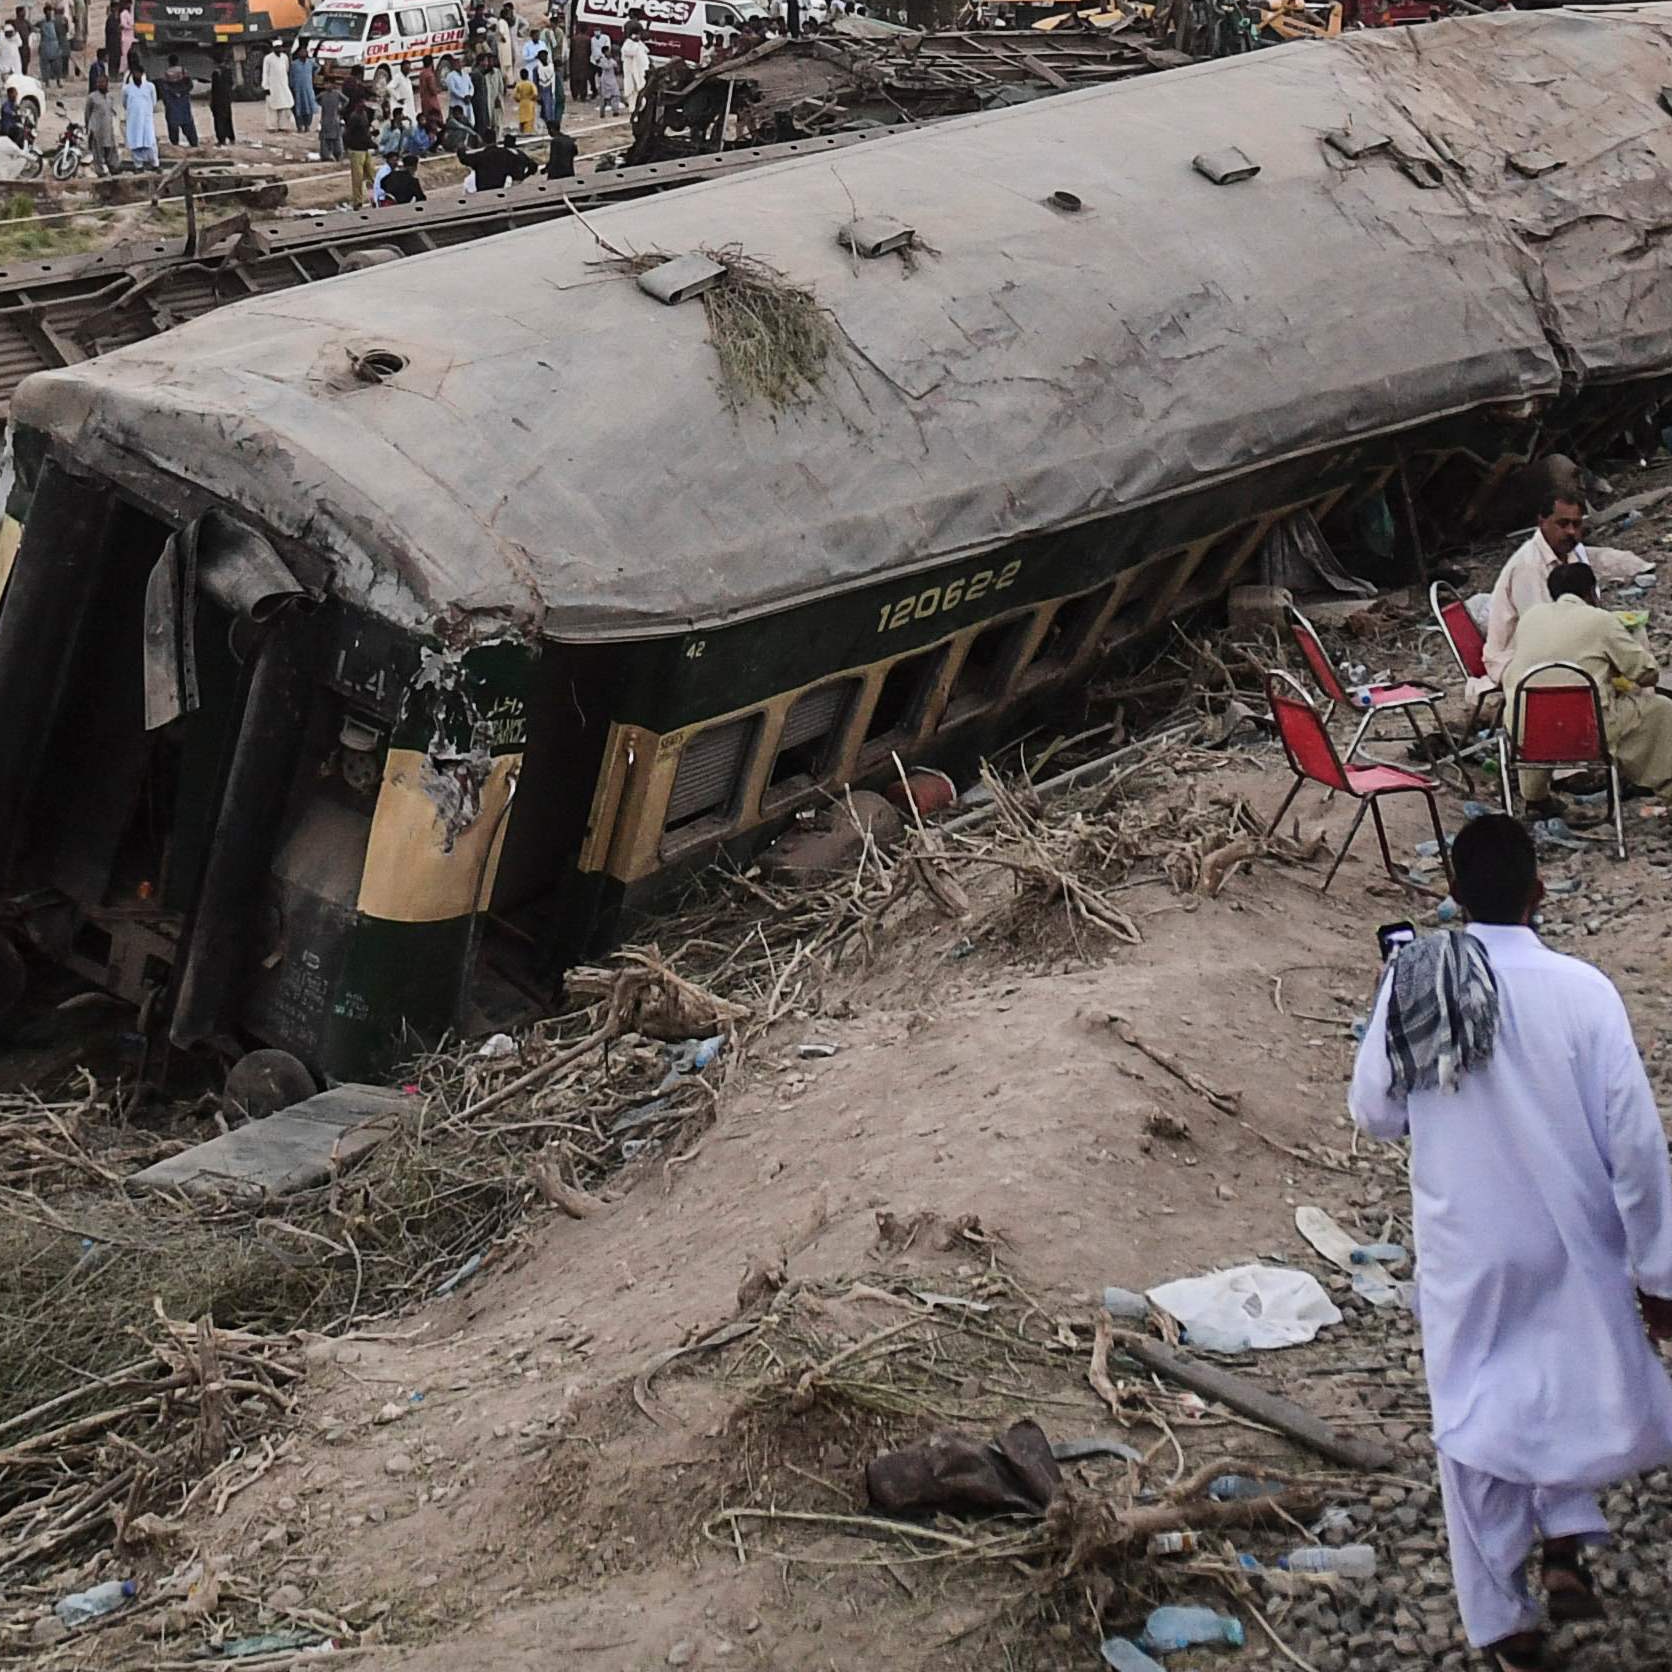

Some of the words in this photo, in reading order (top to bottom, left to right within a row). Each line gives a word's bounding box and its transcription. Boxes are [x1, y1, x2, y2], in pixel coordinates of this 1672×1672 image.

[166, 6, 203, 15] VOLVO
[431, 30, 464, 43] EDHI
[366, 42, 390, 56] EDHI
[877, 559, 1022, 632] 12062-2
[685, 640, 707, 660] 42
